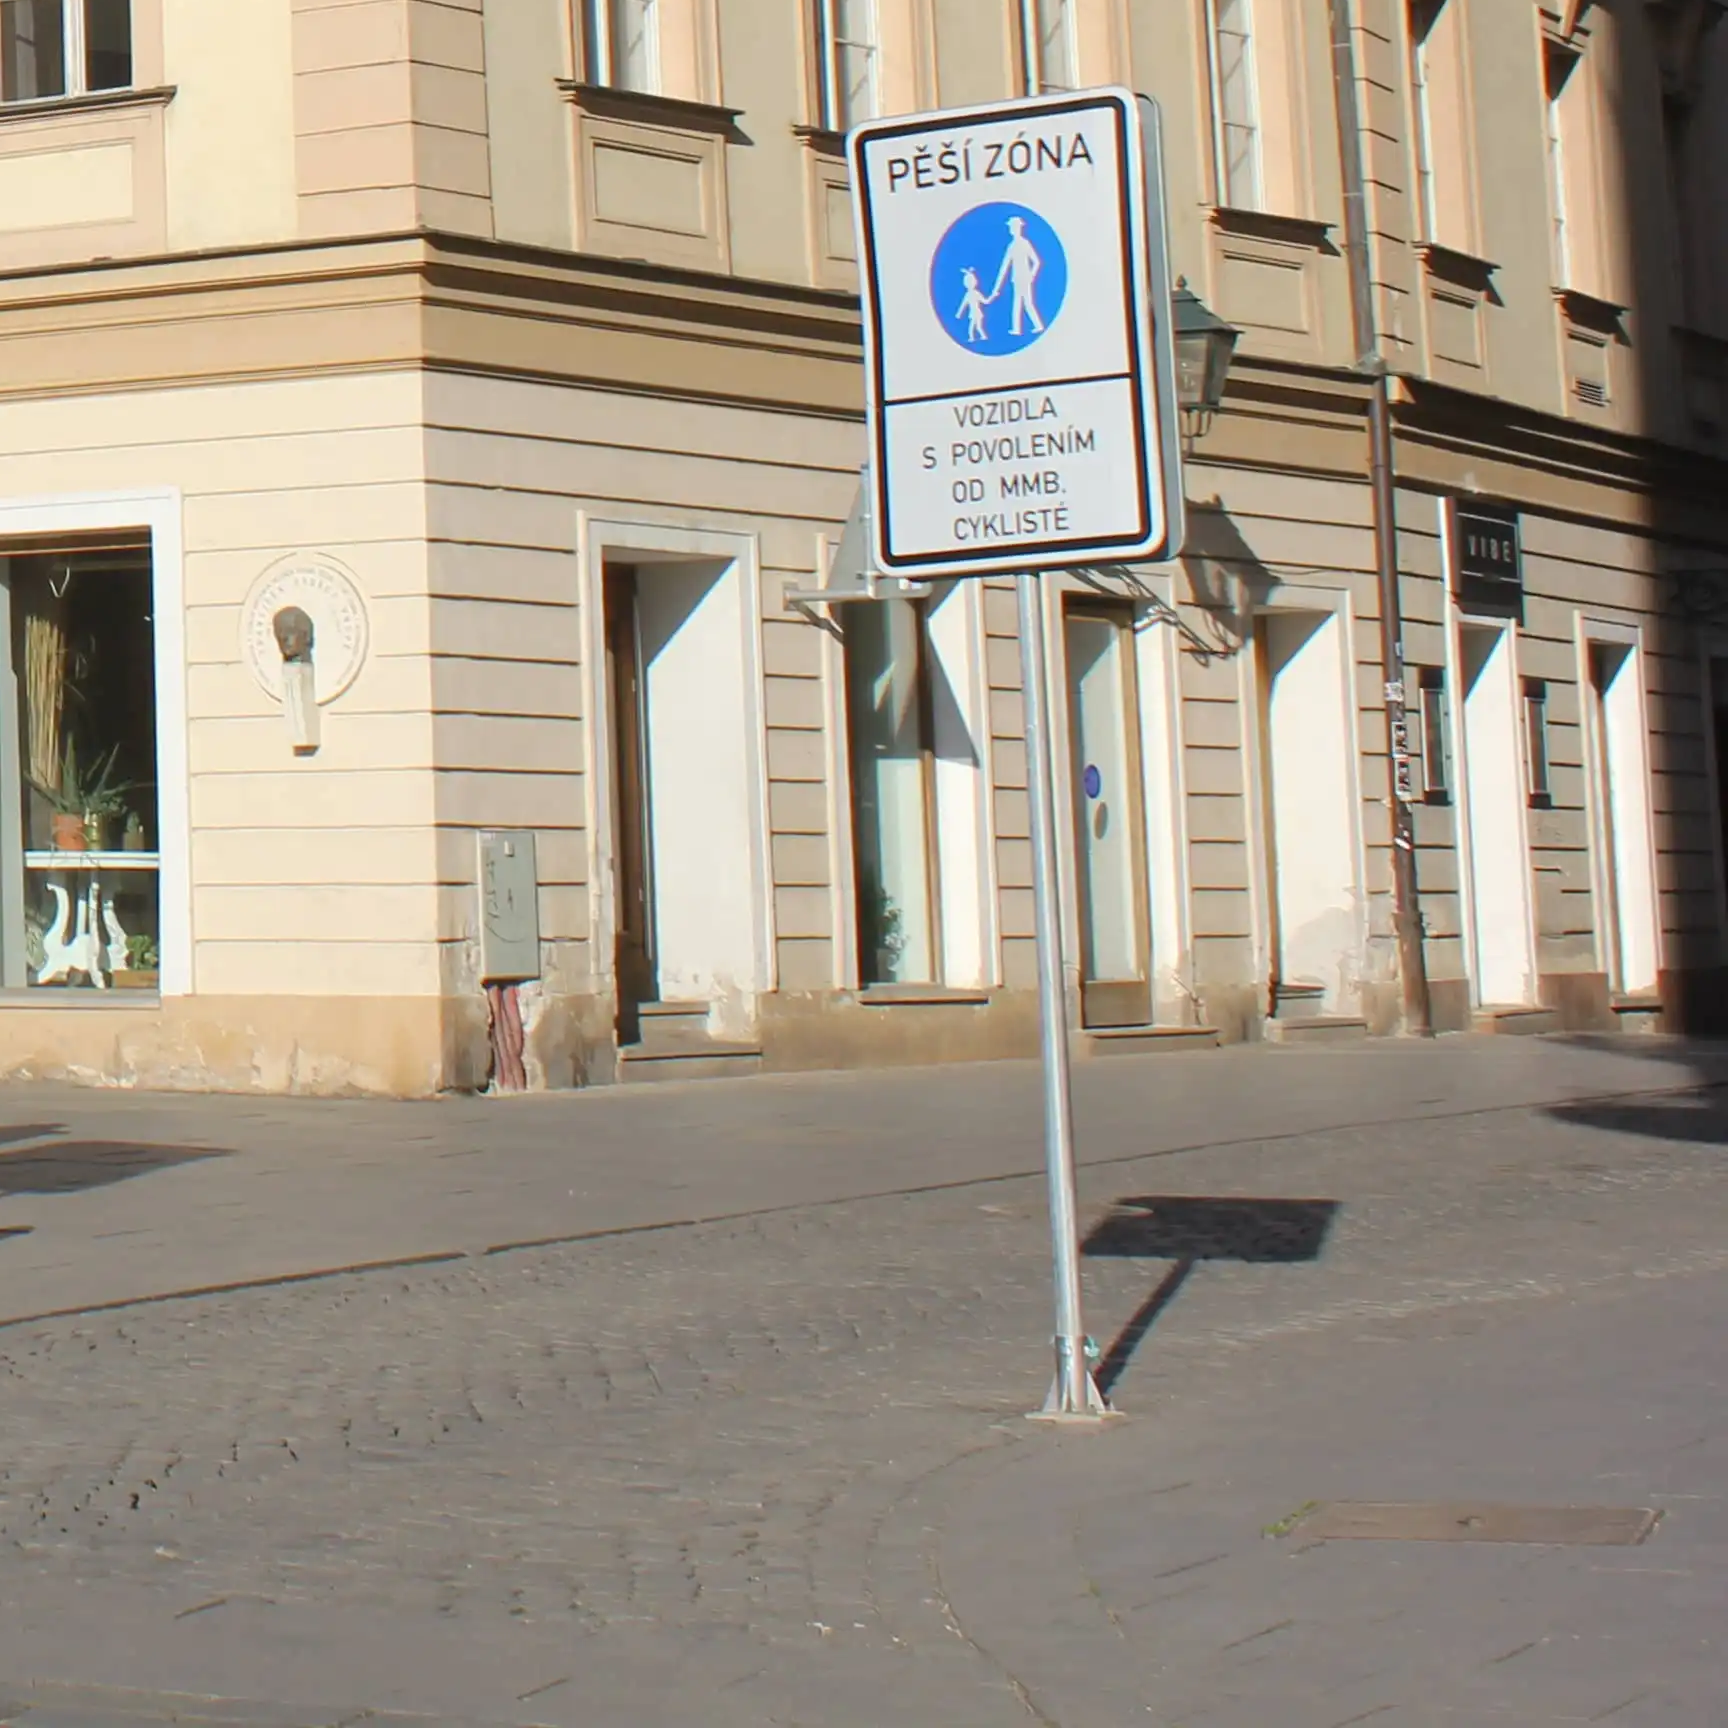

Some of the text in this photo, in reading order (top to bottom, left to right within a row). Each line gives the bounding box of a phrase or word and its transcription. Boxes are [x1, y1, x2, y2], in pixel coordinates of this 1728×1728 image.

[887, 132, 1093, 193] PĚŠÍ ZÓNA
[953, 396, 1057, 428] VOZIDLA
[922, 427, 1096, 470] S POVOLENÍM
[952, 471, 1067, 504] OD MMB.
[953, 501, 1069, 541] CYKLISTÉ
